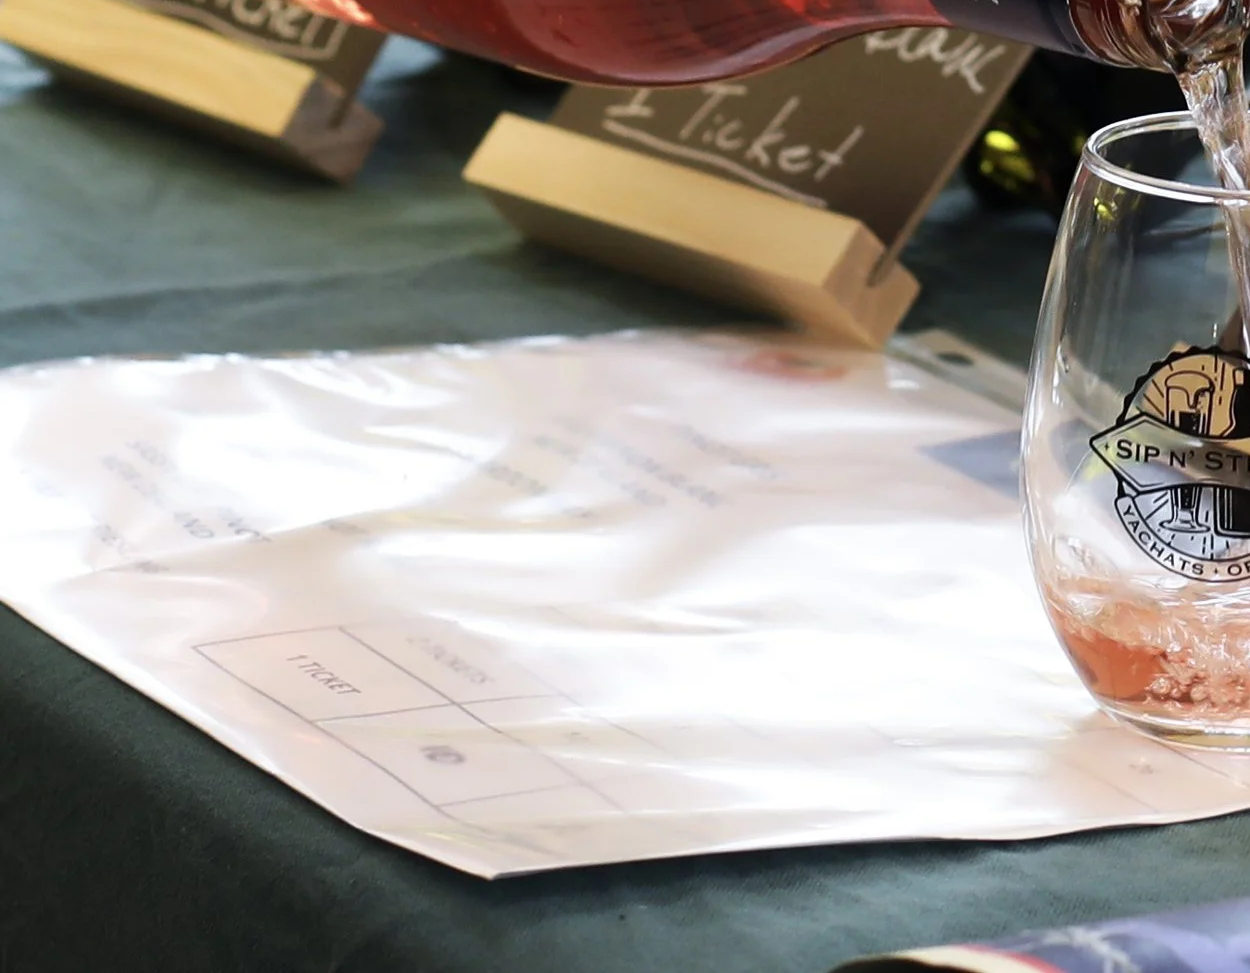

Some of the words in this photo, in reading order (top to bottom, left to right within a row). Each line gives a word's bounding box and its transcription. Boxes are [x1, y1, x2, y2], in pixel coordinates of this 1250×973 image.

[679, 83, 864, 181] Ticket
[1115, 438, 1161, 464] SIP
[1121, 503, 1204, 577] YACHATS
[297, 661, 362, 696] TICKET
